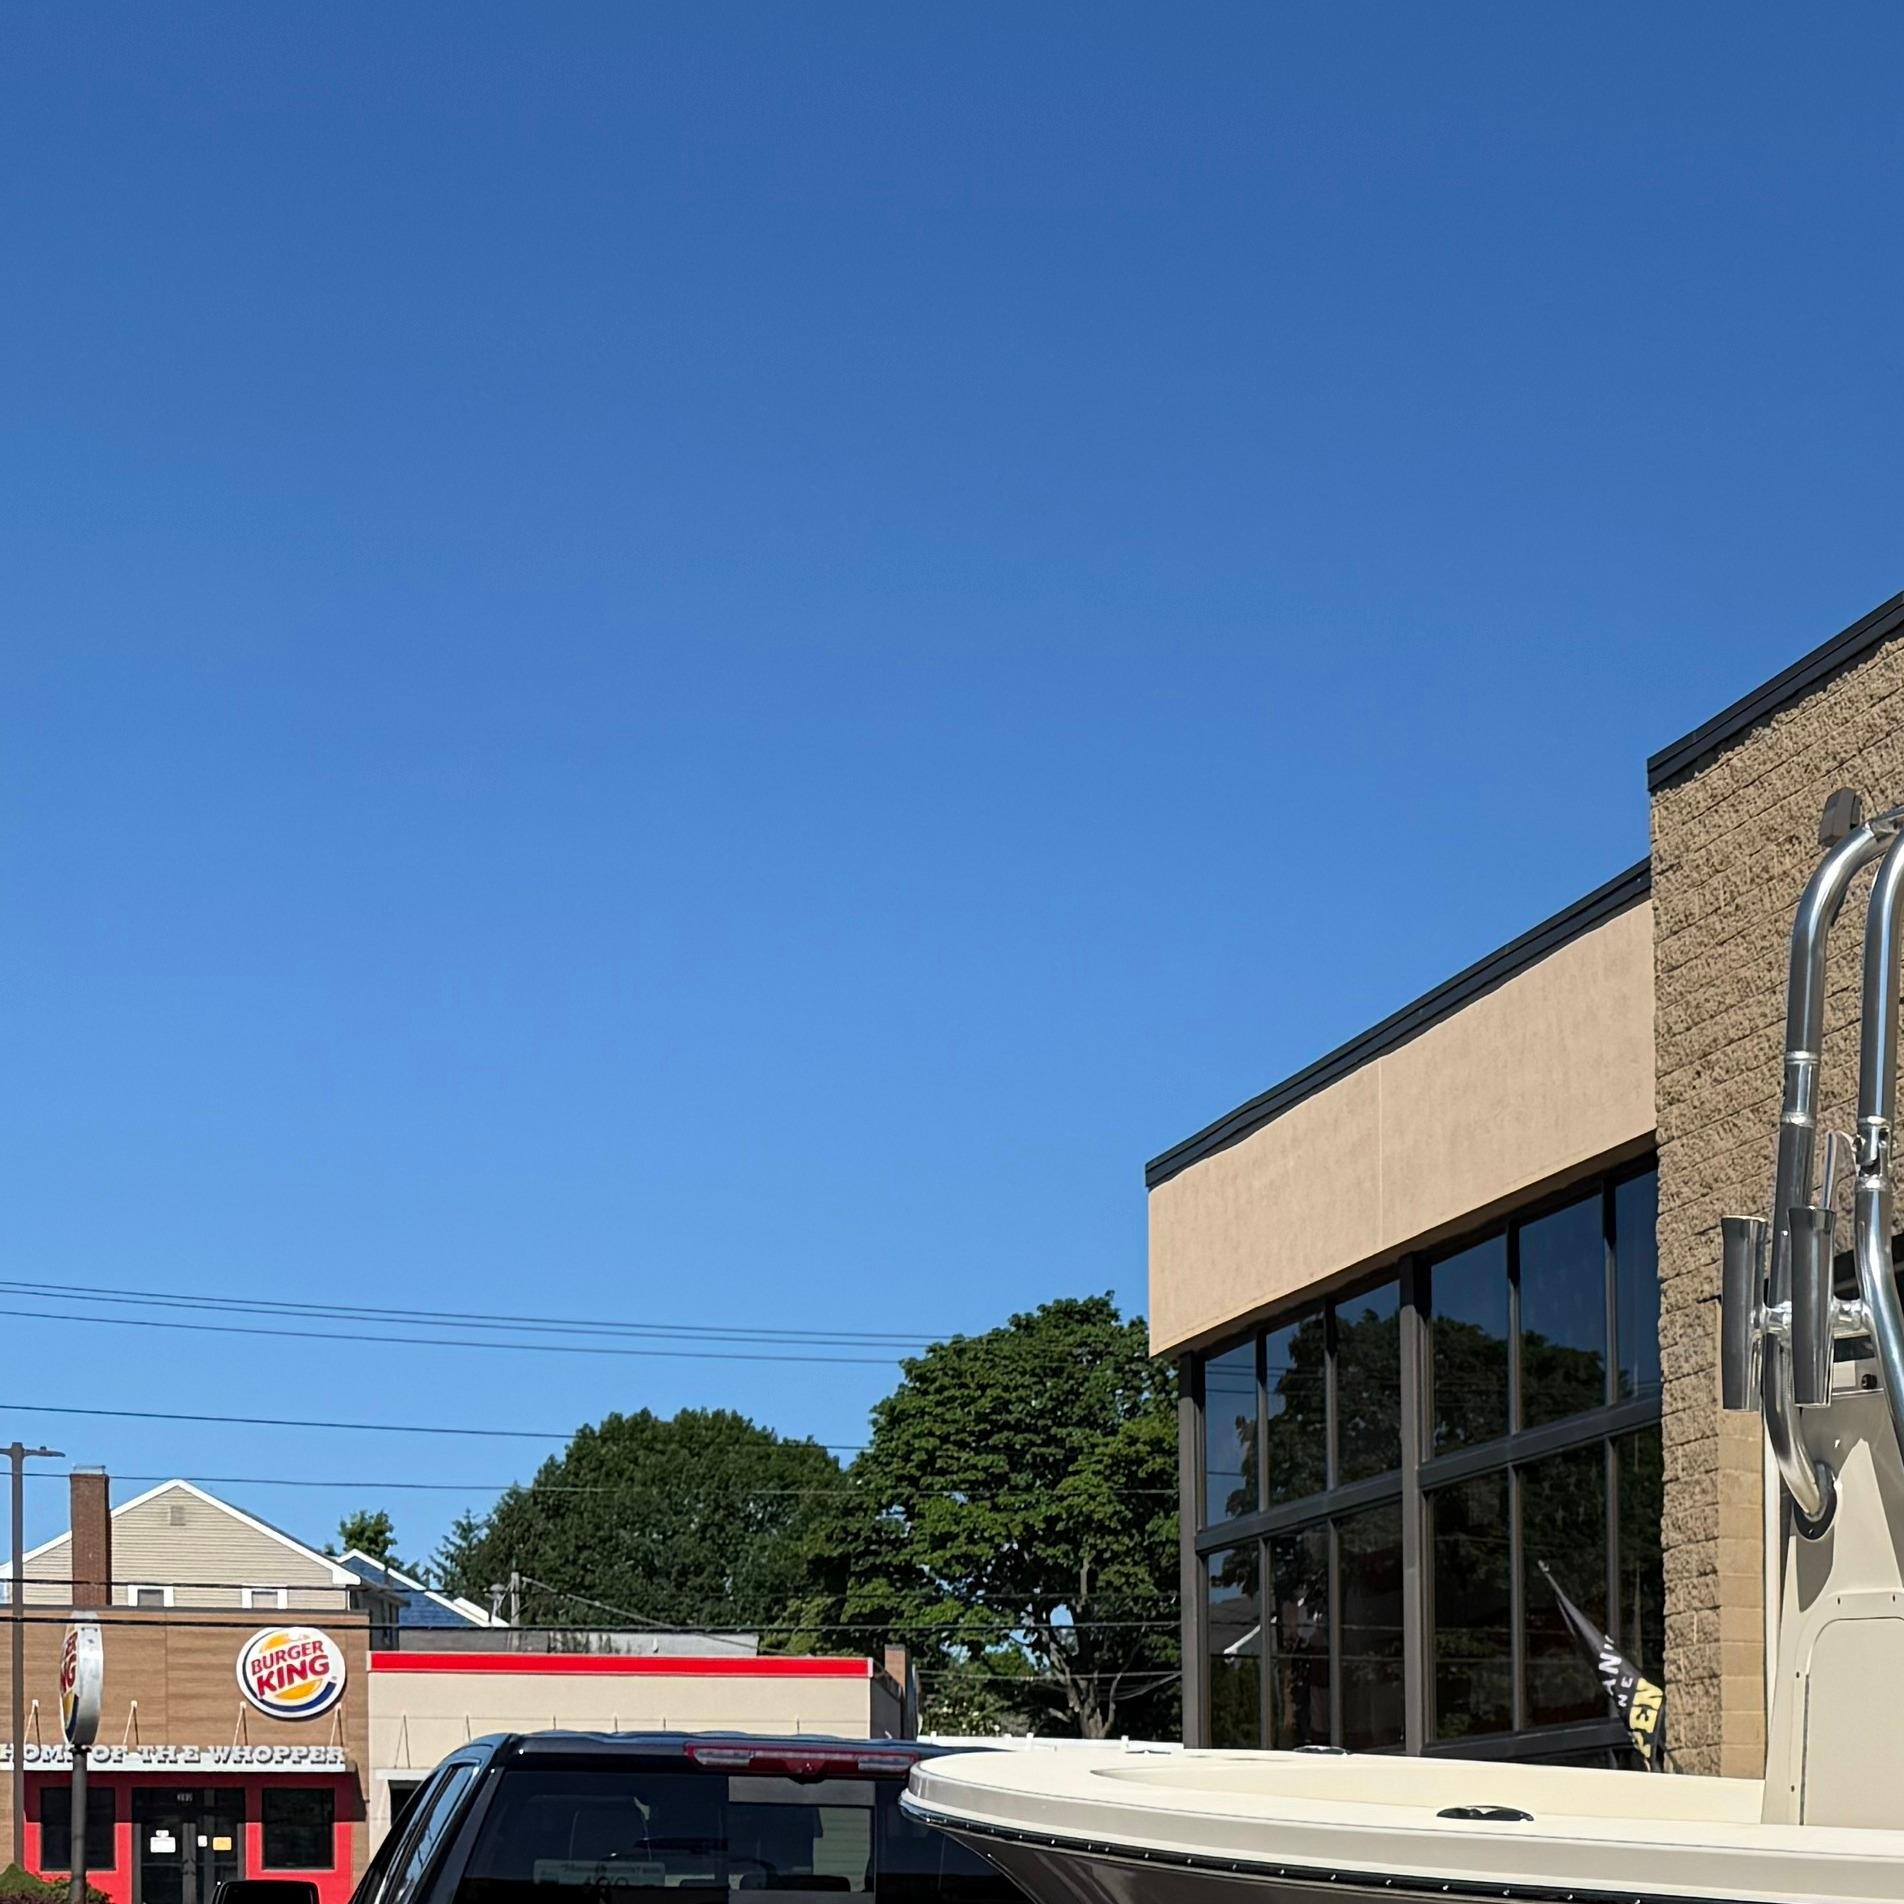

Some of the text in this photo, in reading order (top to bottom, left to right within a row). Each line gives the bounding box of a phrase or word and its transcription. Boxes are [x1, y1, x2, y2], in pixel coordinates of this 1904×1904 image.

[250, 1639, 325, 1676] BURGER
[256, 1653, 331, 1698] KING
[92, 1744, 128, 1764] OF
[136, 1744, 201, 1764] THE
[207, 1744, 346, 1764] WHOPPER
